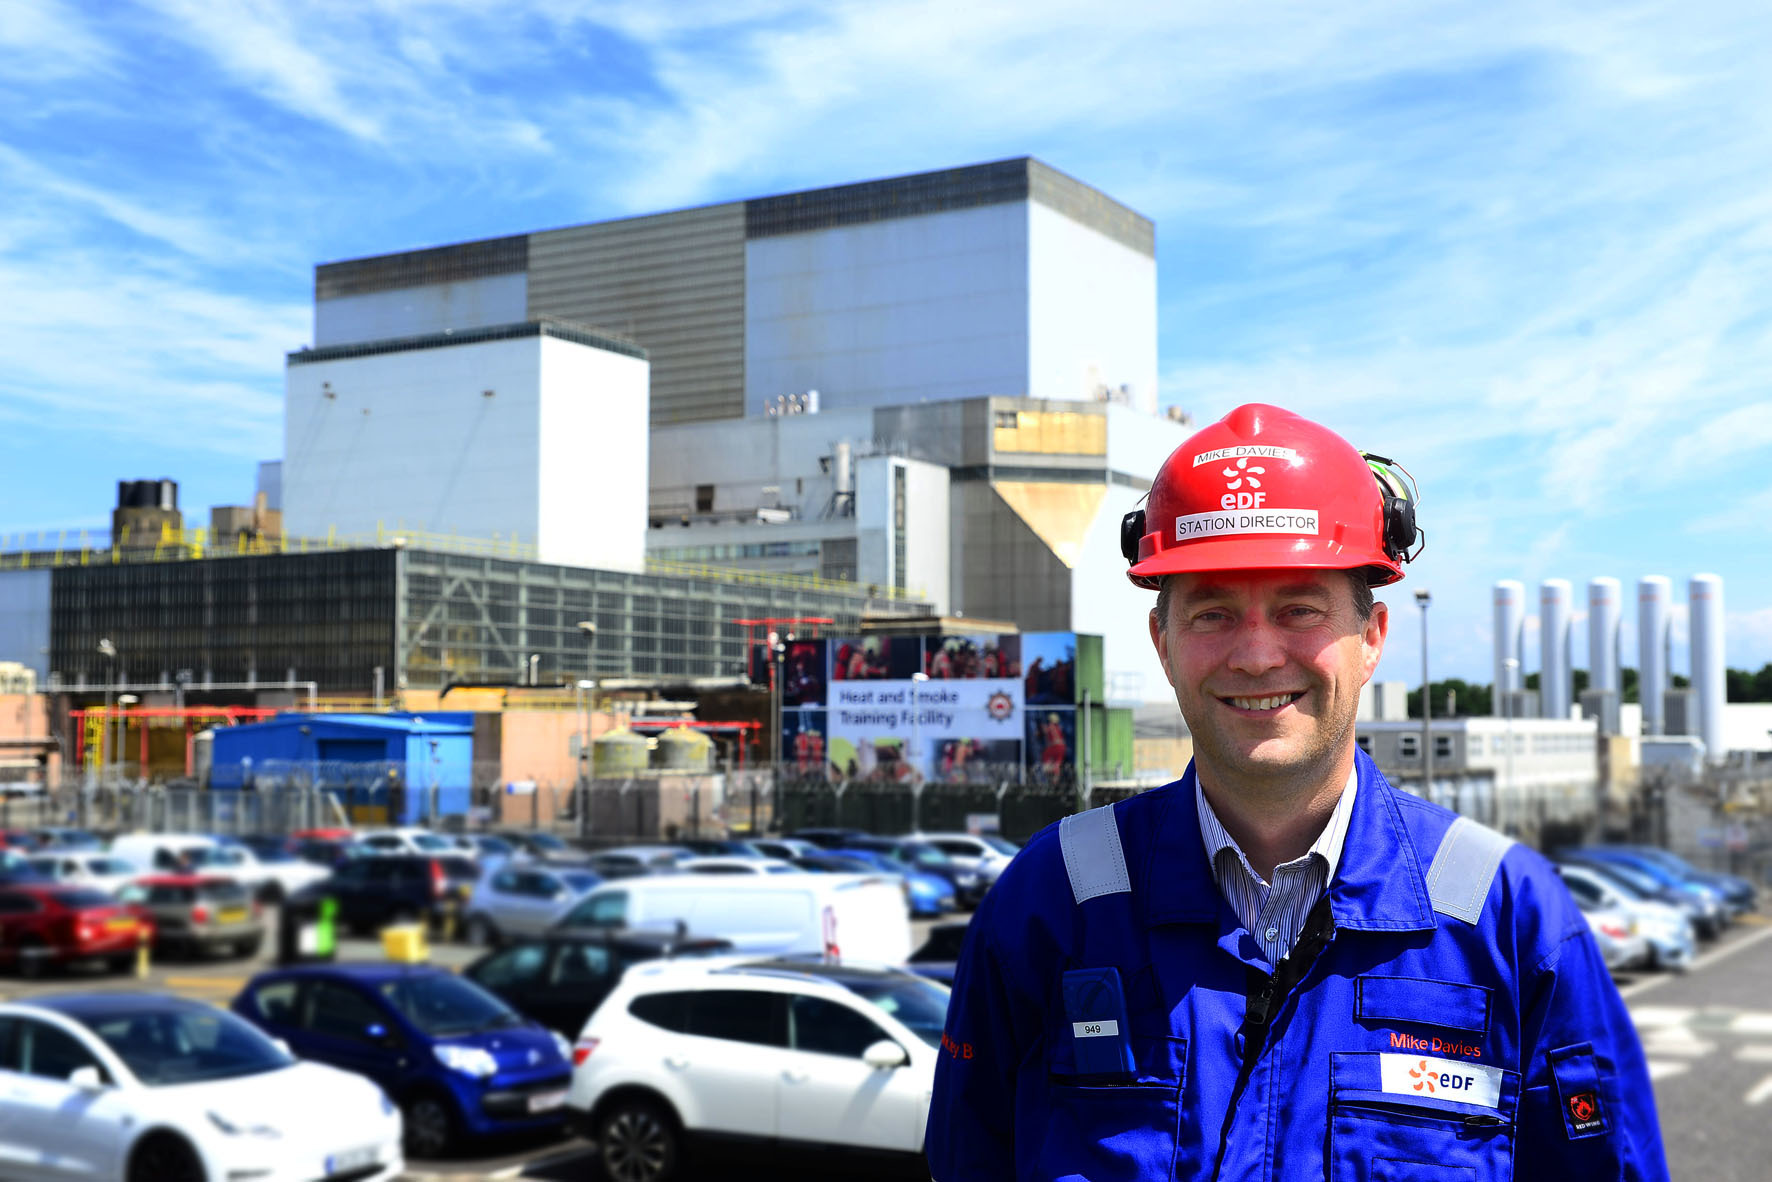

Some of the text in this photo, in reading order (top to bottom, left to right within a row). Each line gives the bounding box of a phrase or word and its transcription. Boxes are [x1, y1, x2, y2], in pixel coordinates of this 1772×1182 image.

[1197, 448, 1231, 463] MIKE
[1179, 514, 1316, 535] STATION DIRECTOR
[839, 691, 873, 704] Heat
[879, 691, 905, 704] and
[840, 710, 954, 729] Training Facility
[1084, 1025, 1101, 1034] 949
[963, 1042, 974, 1059] B
[1390, 1032, 1481, 1057] Mike Davies
